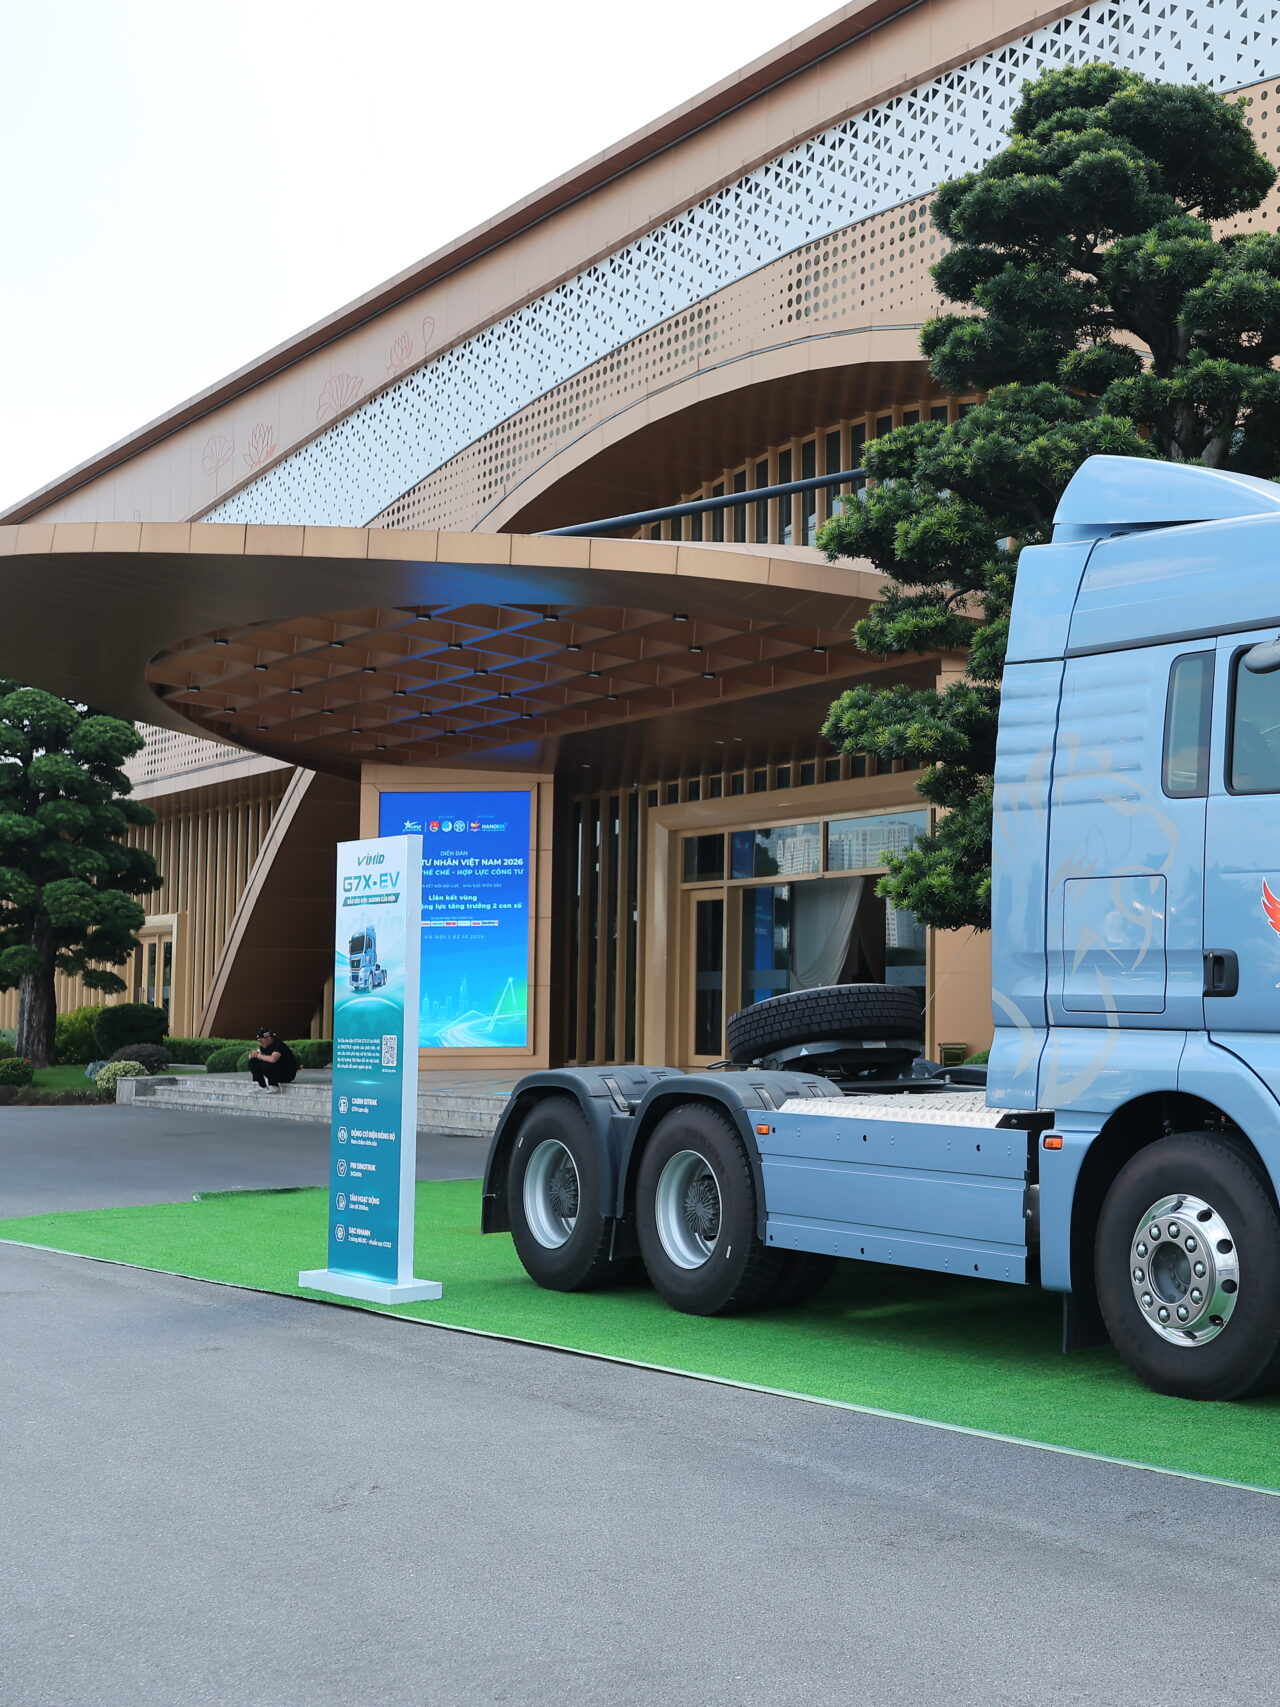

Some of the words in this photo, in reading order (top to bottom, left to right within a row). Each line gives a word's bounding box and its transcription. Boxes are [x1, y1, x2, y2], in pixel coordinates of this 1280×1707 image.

[433, 857, 459, 866] NHÂN
[460, 857, 480, 867] VIỆT
[481, 858, 502, 866] NAM
[503, 858, 524, 866] 2026
[491, 867, 512, 875] CÔNG
[459, 894, 478, 902] vùng
